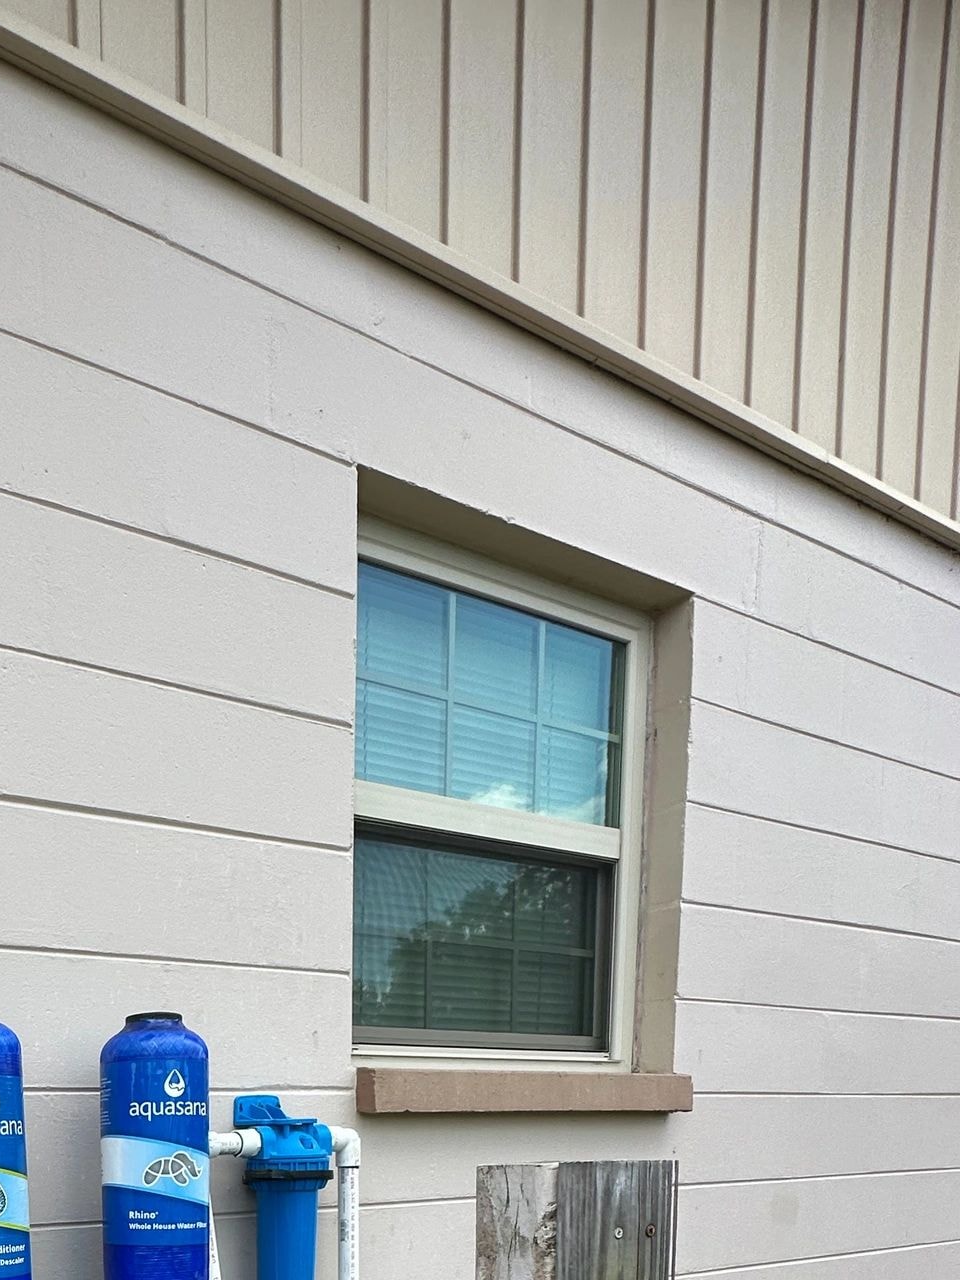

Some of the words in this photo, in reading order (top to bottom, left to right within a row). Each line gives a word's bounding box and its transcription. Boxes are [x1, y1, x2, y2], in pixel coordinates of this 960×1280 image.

[129, 1101, 207, 1121] aquasana
[129, 1223, 151, 1231] Whole
[177, 1222, 196, 1230] Water
